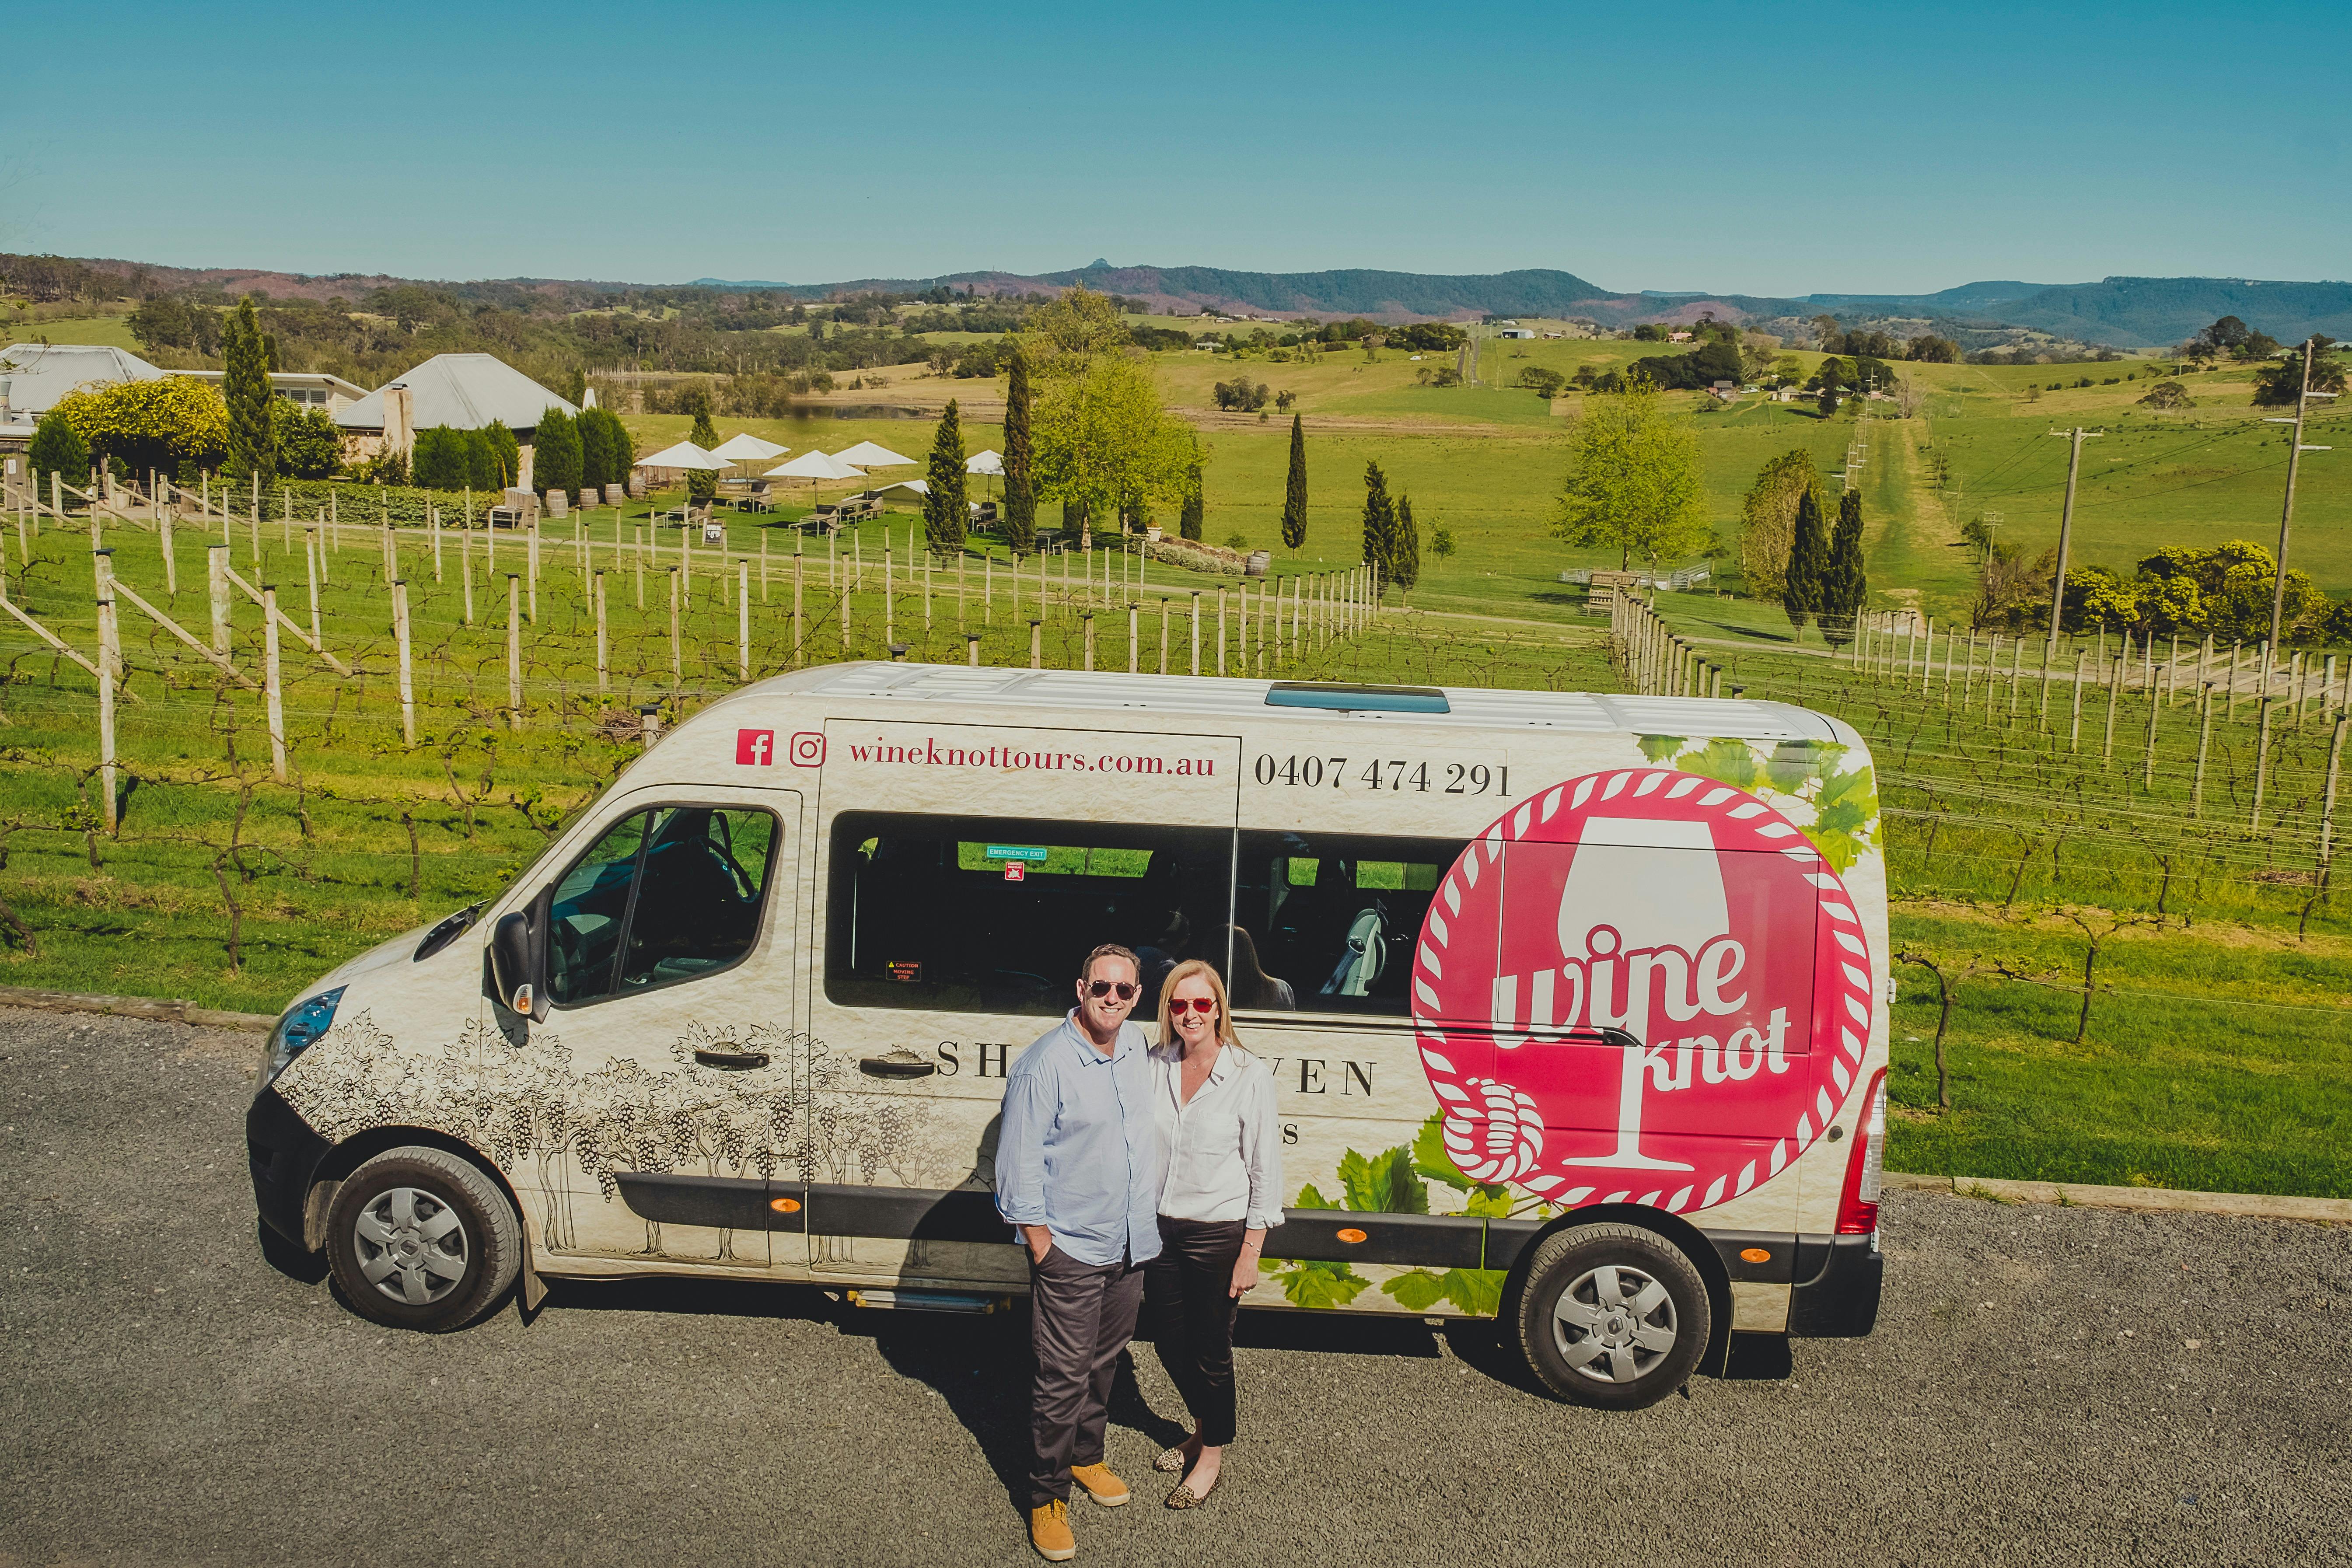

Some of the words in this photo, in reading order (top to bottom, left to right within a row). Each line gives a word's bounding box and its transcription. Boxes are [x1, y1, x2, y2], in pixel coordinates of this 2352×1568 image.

[849, 737, 1215, 776] wineknottours.com.au
[1255, 754, 1347, 788] 0407
[1361, 759, 1430, 792] 474
[1445, 763, 1512, 796] 291
[1491, 930, 1747, 1049] wine
[1621, 1006, 1791, 1092] knot
